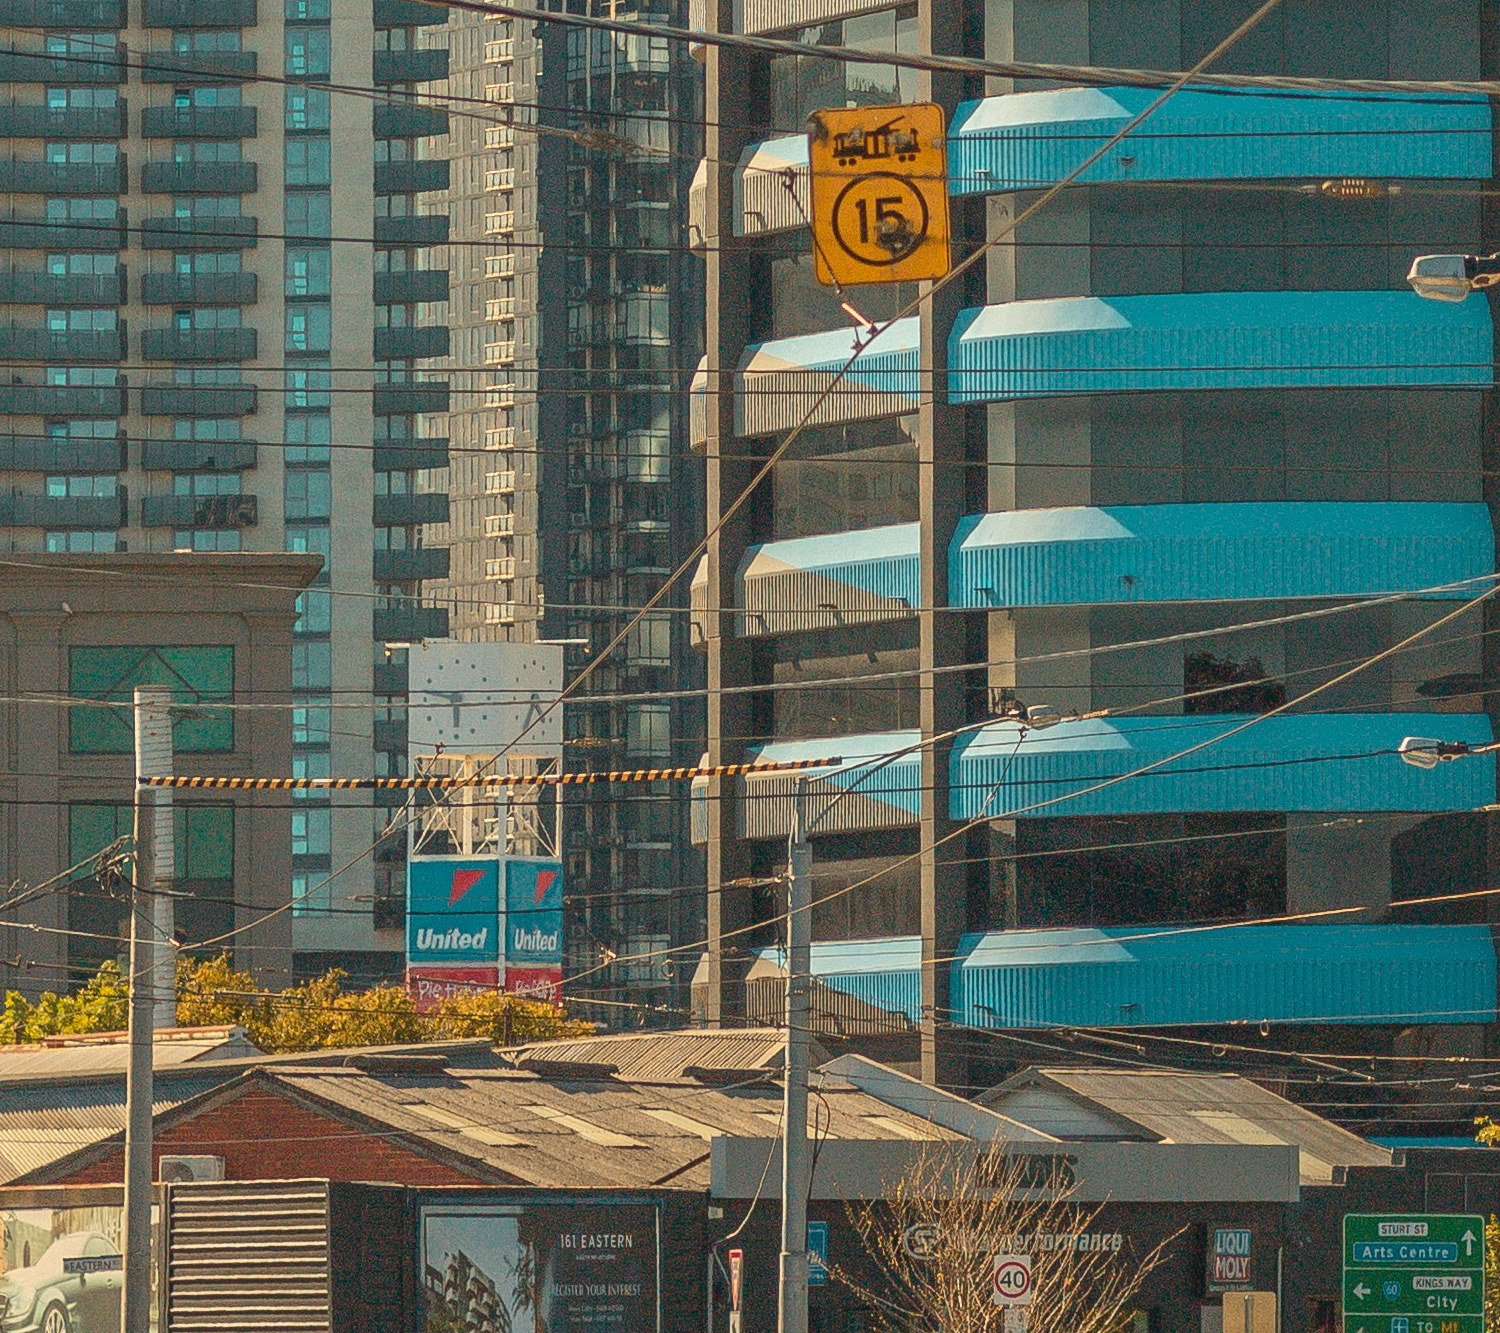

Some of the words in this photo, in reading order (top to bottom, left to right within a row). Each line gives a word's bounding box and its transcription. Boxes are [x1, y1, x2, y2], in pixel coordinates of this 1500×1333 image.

[855, 196, 914, 247] 15
[416, 927, 488, 950] United
[514, 928, 558, 951] United
[1381, 1225, 1411, 1234] STURT
[1414, 1225, 1425, 1234] ST
[560, 1234, 576, 1248] 161
[581, 1234, 633, 1248] EASTERN
[1216, 1233, 1250, 1255] LIQUI
[1362, 1246, 1394, 1258] Arts
[1399, 1246, 1449, 1258] Centre
[70, 1260, 112, 1271] EASTERN
[1215, 1257, 1250, 1279] MOLY
[1000, 1271, 1025, 1288] 40
[1416, 1279, 1444, 1288] KINGS
[1447, 1279, 1468, 1288] WAY
[1426, 1295, 1458, 1312] City
[1416, 1321, 1433, 1333] TO
